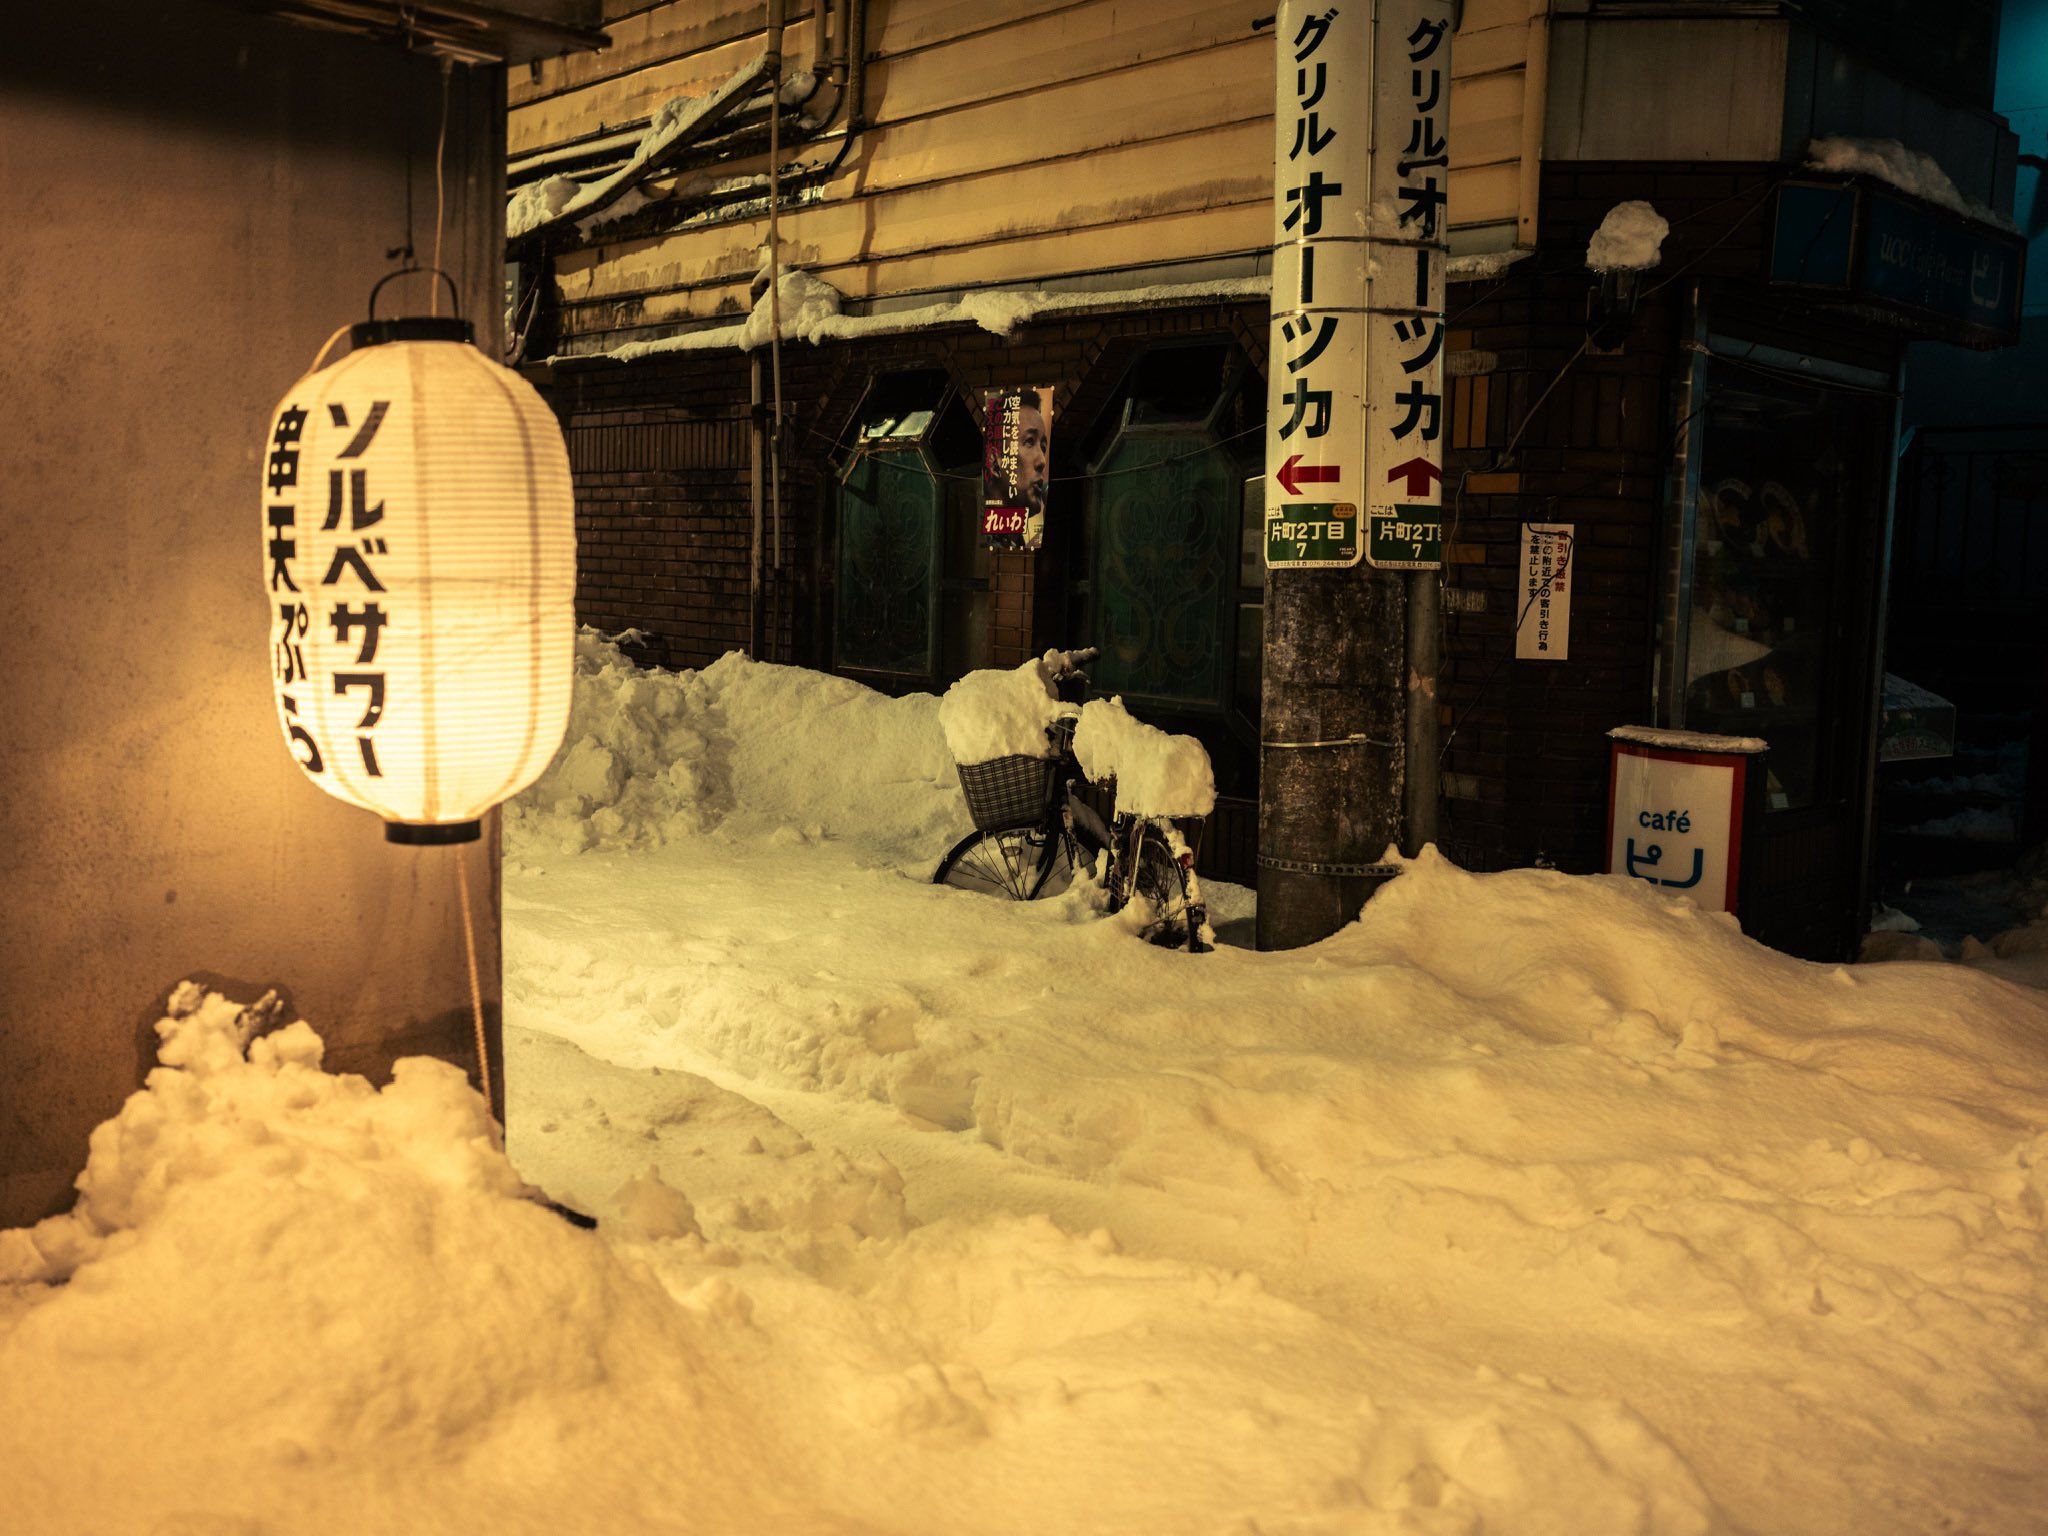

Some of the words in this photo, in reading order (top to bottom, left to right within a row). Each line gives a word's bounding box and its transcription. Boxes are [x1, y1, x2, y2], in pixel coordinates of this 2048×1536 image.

[1279, 8, 1343, 441] グリルオーツカ
[1390, 18, 1449, 441] グリルオーツカ
[1008, 396, 1021, 499] 空気を読まない
[985, 509, 1022, 532] れいわ
[1271, 521, 1345, 542] 片町2丁目
[1296, 542, 1307, 558] 7
[1412, 543, 1422, 559] 7
[320, 401, 391, 777] ソルベサワー
[1639, 809, 1691, 834] café
